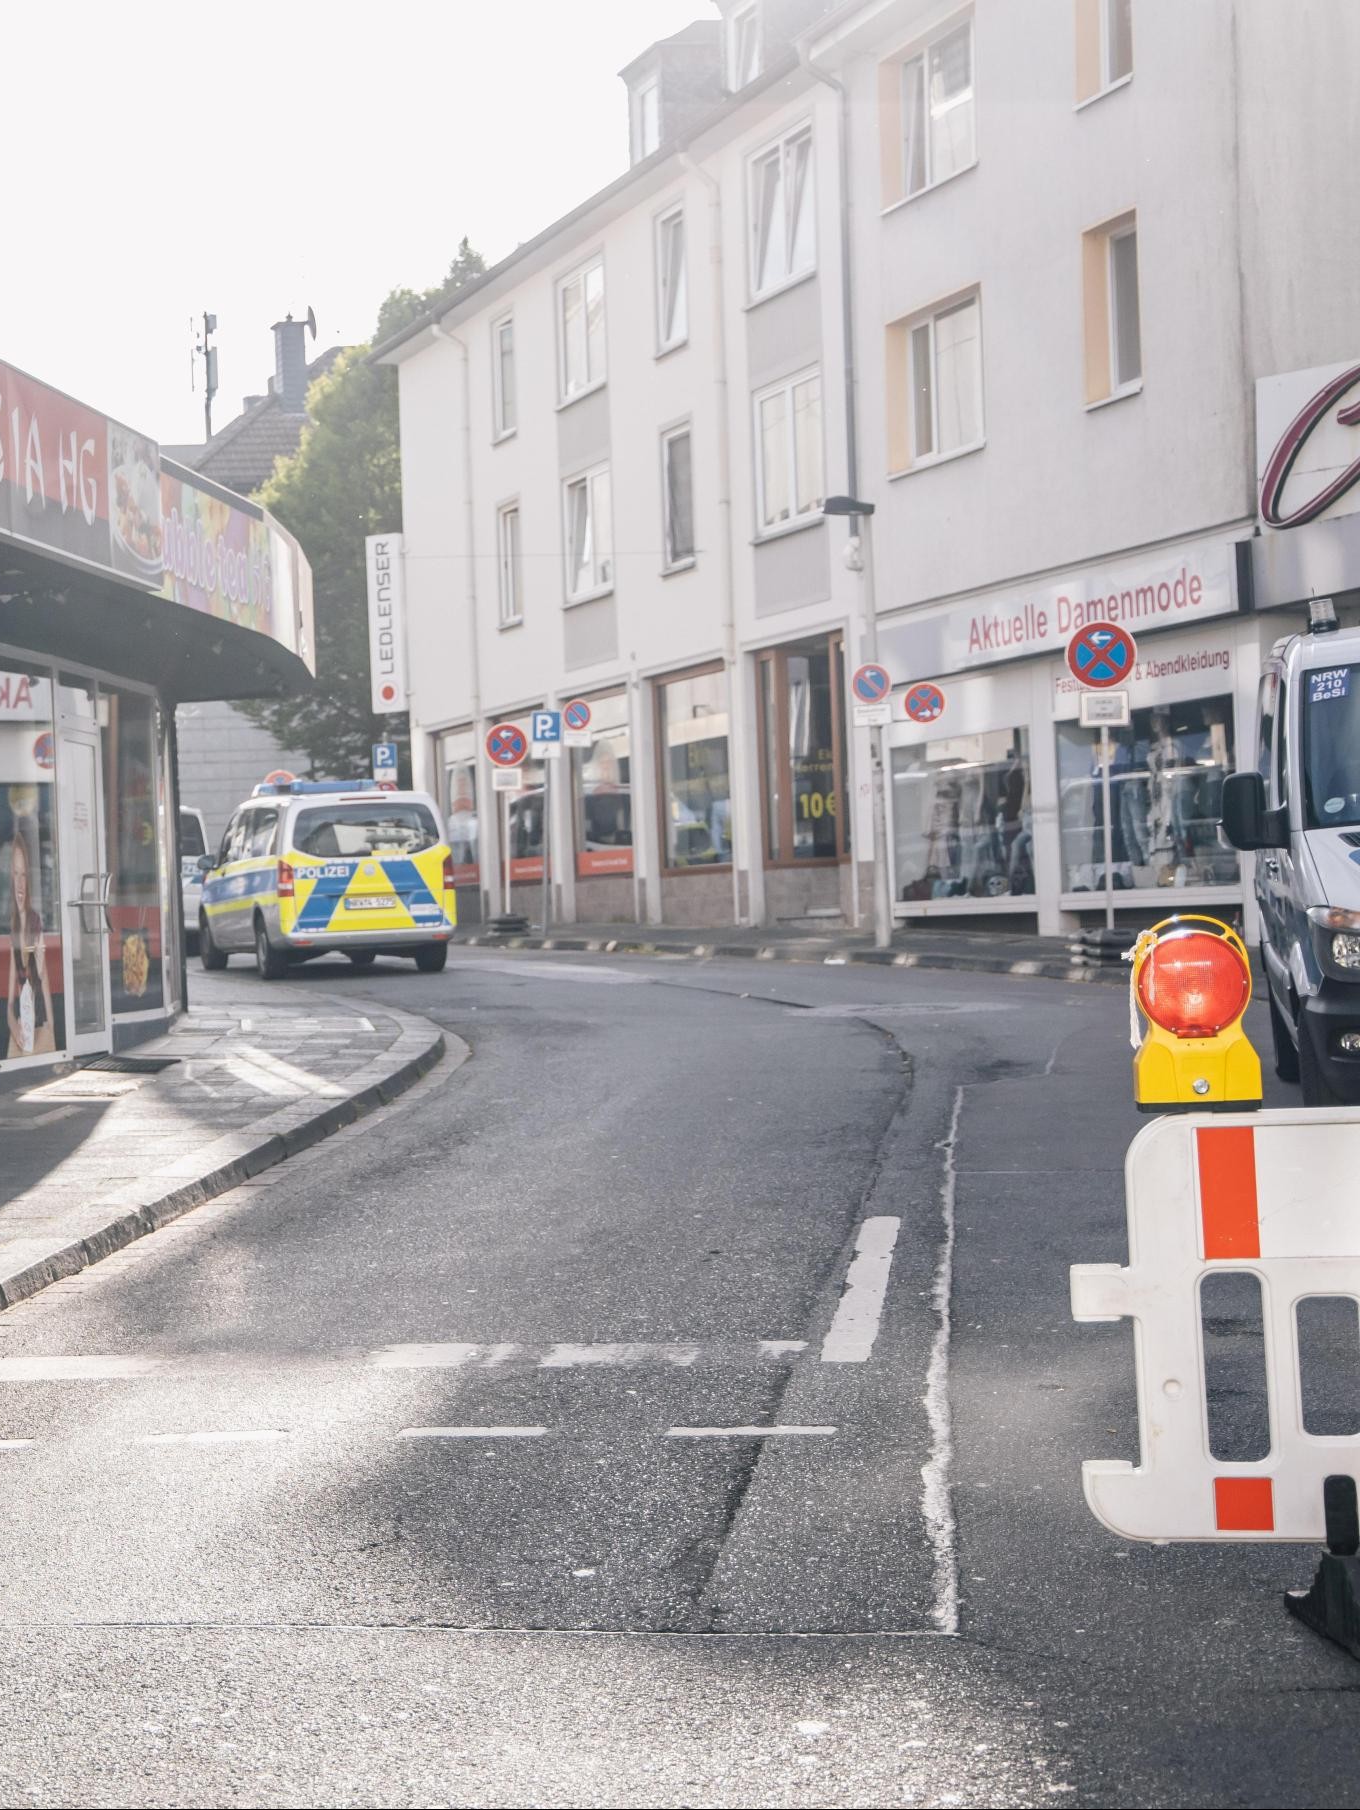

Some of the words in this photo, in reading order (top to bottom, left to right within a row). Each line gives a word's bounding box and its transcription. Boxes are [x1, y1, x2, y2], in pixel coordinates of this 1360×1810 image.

[57, 426, 97, 526] HG
[376, 541, 395, 675] LEDLENSER
[968, 603, 1048, 654] Aktuelle
[1057, 567, 1203, 635] Damenmode
[1146, 649, 1230, 679] Abendkleidung
[1312, 668, 1348, 684] NRW
[1316, 680, 1343, 692] 210
[1312, 687, 1346, 702] BeSi
[296, 865, 350, 879] POLIZEI
